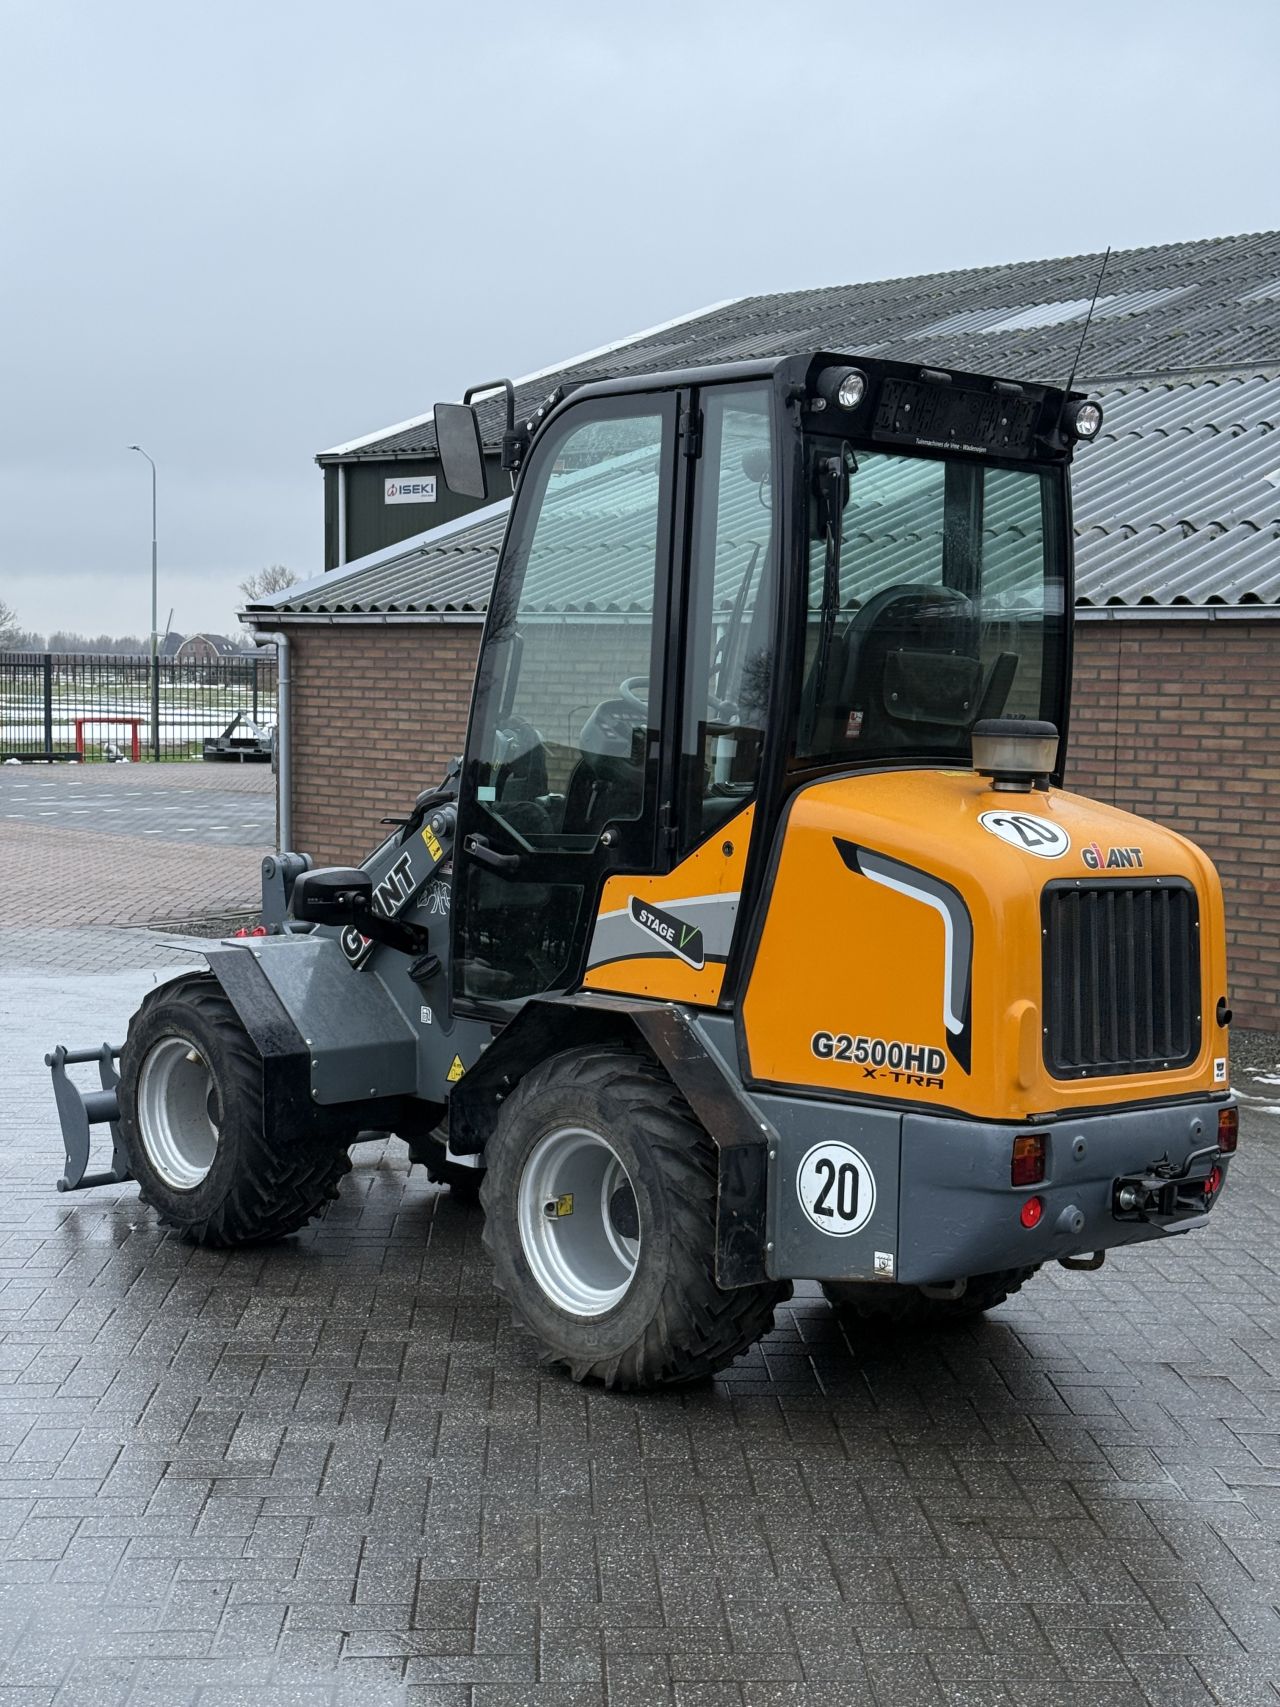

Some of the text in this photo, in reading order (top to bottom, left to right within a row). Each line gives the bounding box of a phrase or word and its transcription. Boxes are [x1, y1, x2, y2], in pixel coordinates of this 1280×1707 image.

[399, 483, 434, 495] ISEKI
[992, 816, 1059, 847] 20
[639, 909, 701, 949] STAGE V
[811, 1031, 947, 1075] G2500HD
[862, 1067, 944, 1090] X-TRA
[813, 1158, 860, 1221] 20
